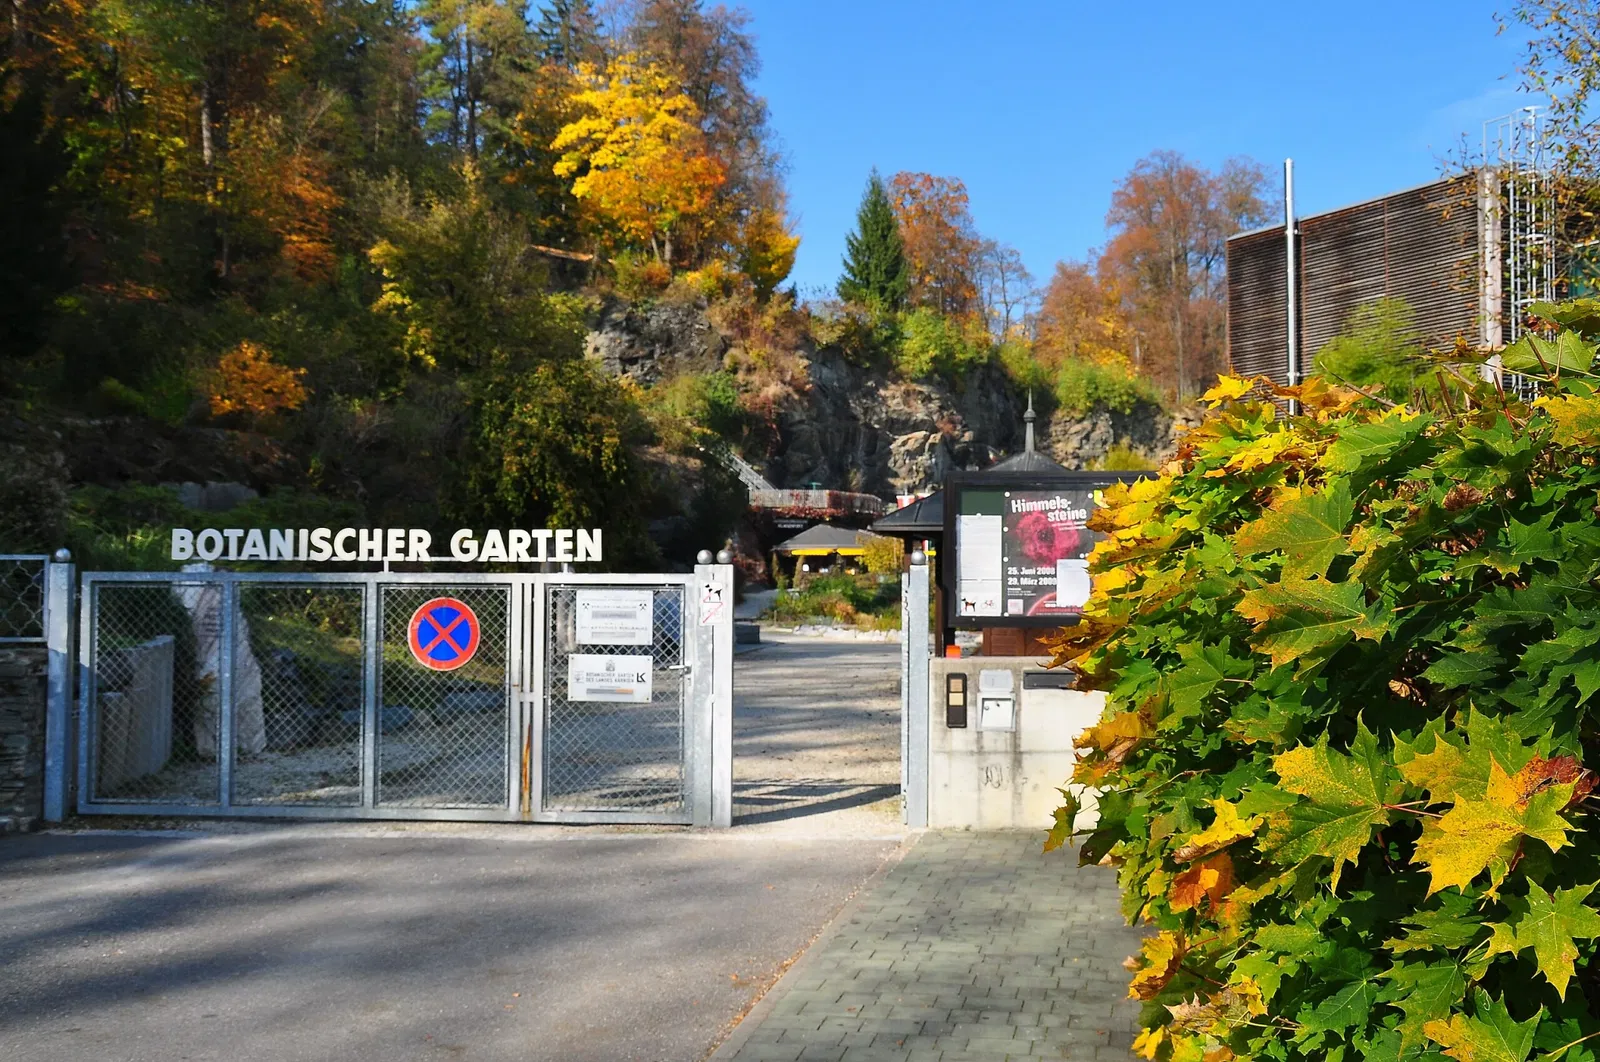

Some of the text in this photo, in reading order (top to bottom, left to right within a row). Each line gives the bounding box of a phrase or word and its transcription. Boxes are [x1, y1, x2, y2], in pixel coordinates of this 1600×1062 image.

[1011, 496, 1072, 513] Himmels-
[1047, 507, 1087, 522] steine
[171, 528, 602, 562] BOTANISCHER GARTEN
[1020, 567, 1036, 575] Juni
[1020, 577, 1038, 585] März
